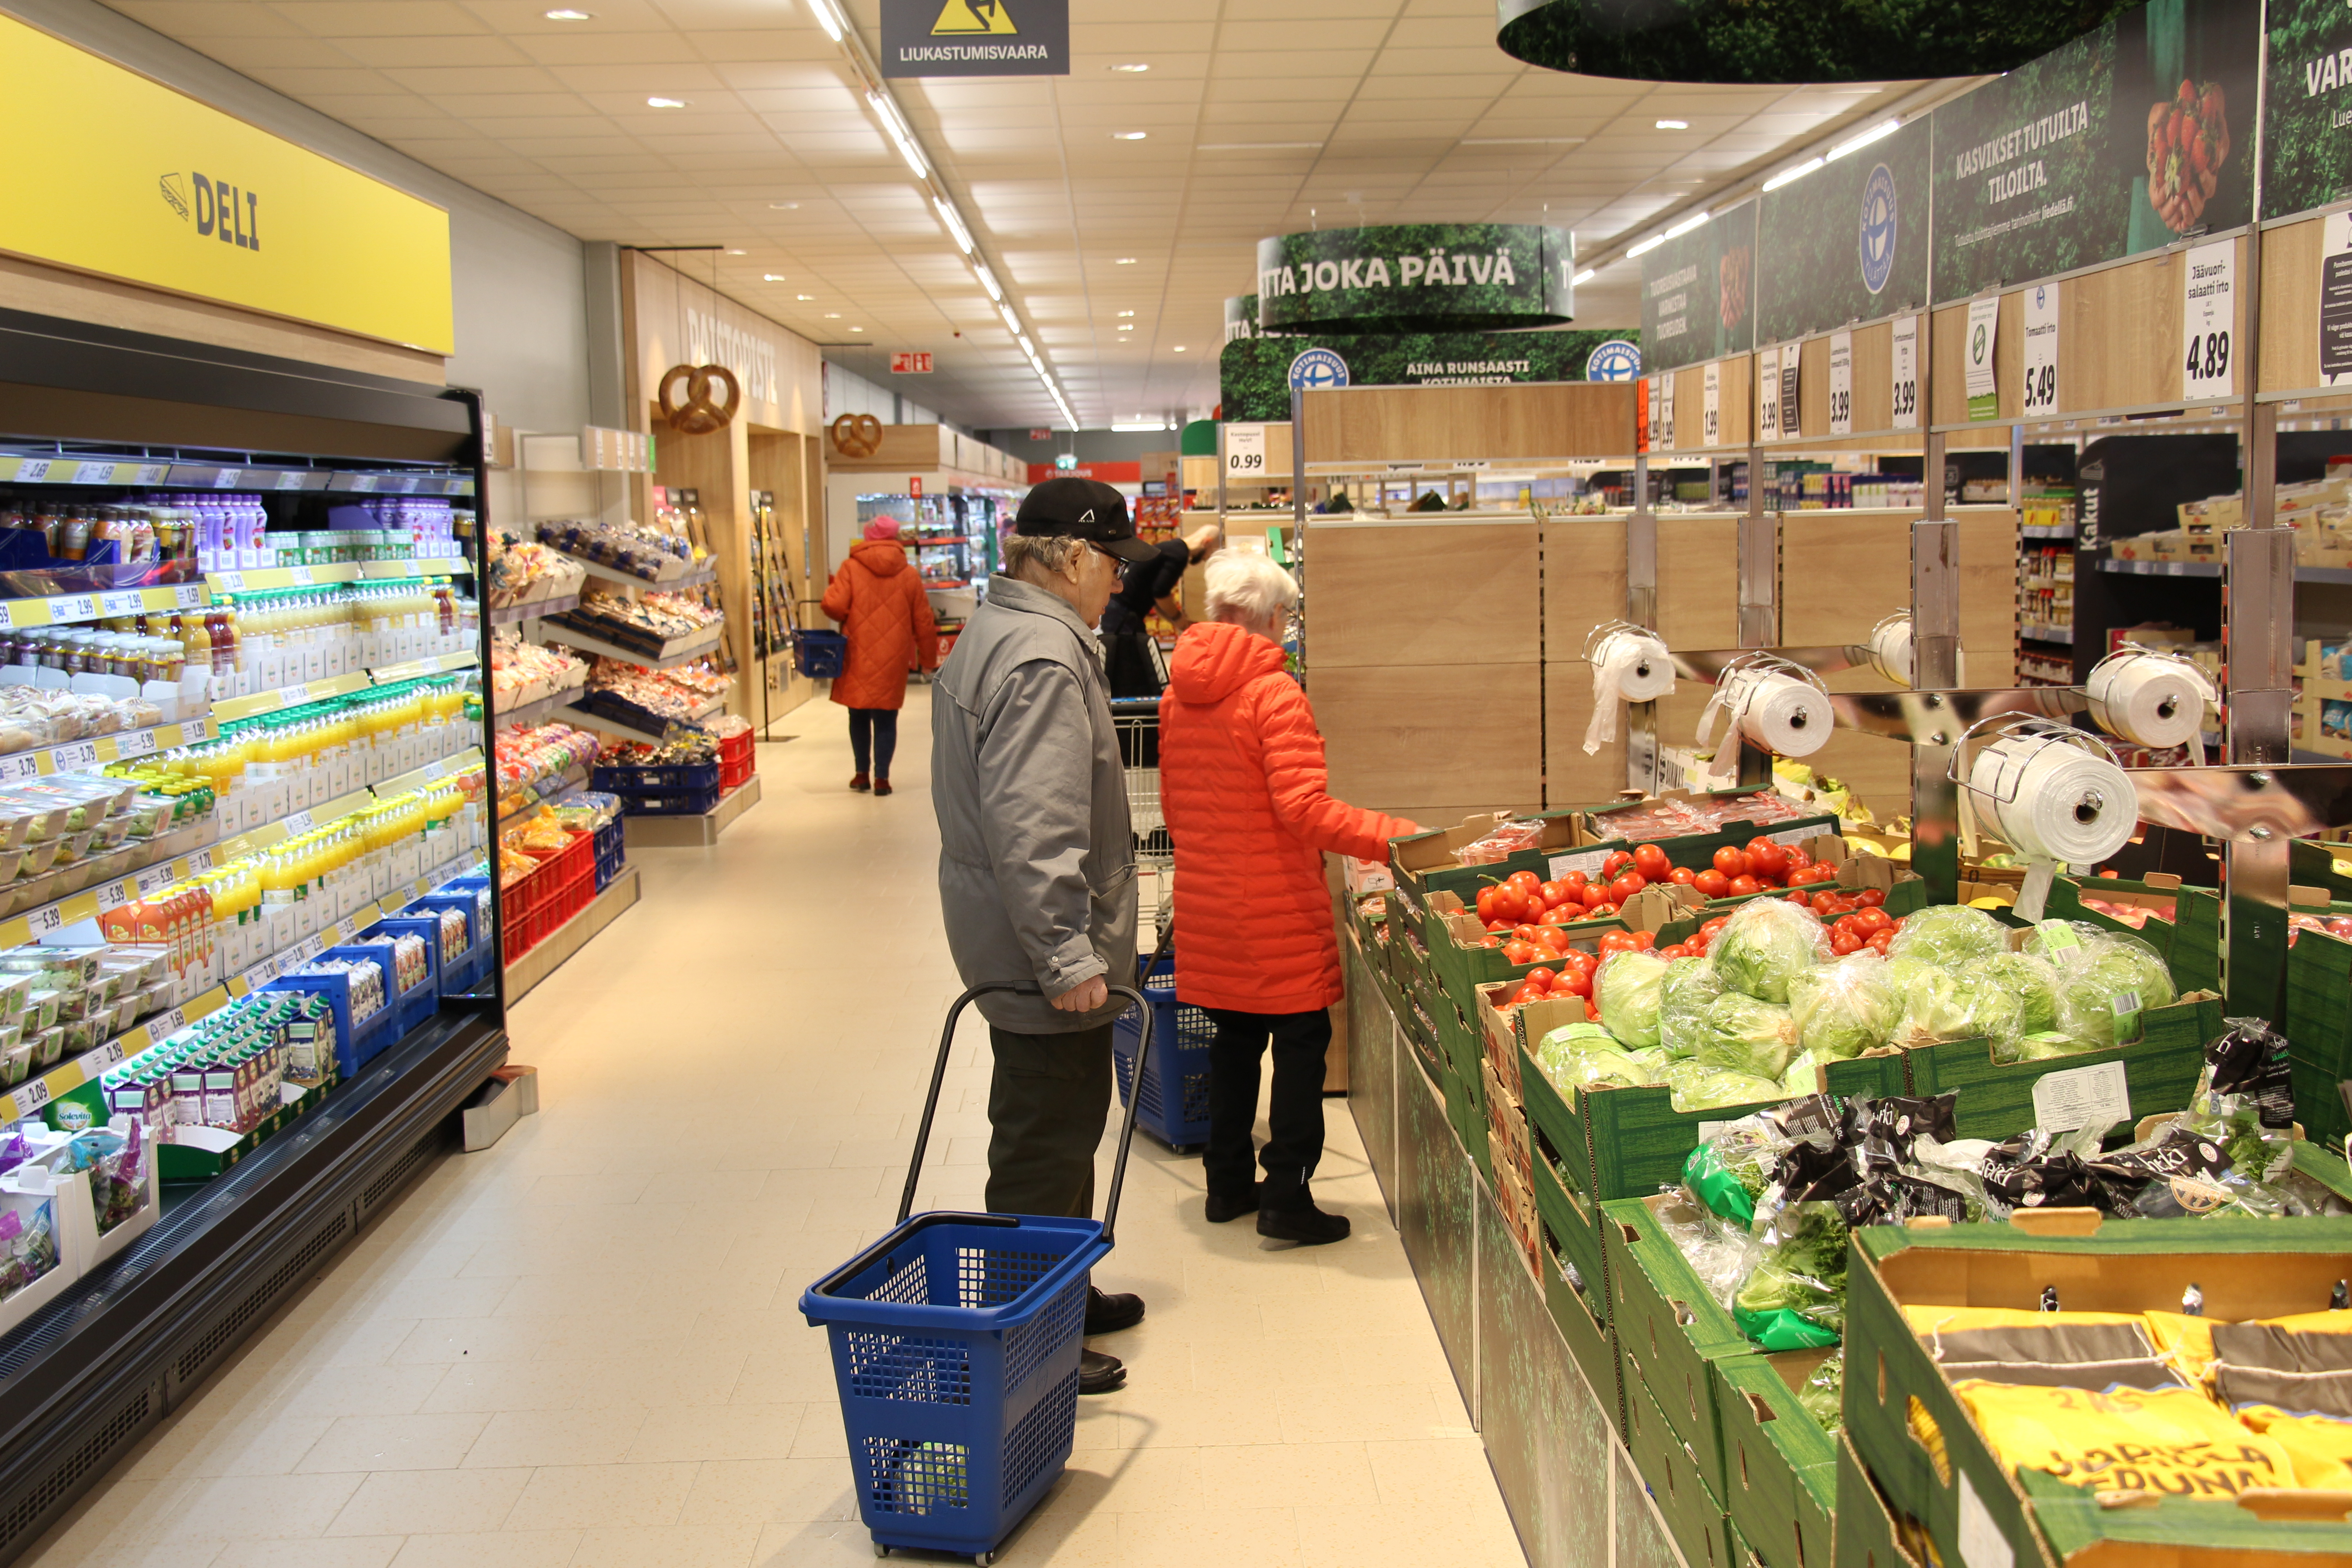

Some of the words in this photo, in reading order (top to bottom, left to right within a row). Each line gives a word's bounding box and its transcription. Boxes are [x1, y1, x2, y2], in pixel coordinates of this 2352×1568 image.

[900, 45, 1048, 62] LIUKASTUMISVAARA
[1956, 129, 2021, 181] KASVIKSET
[2023, 100, 2088, 153] TUTUILTA
[1988, 160, 2048, 205] TILOILTA.
[193, 172, 259, 251] DELI
[1300, 258, 1391, 294] JOKA
[1399, 248, 1515, 287] PÄIVÄ
[2192, 260, 2226, 280] Jäävuori-
[2188, 280, 2215, 299] salaatti
[2216, 278, 2229, 294] irto
[2186, 331, 2229, 380] 4.89
[1292, 354, 1346, 380] KOTIMAISUUS
[1406, 363, 1444, 376] AINA
[1447, 360, 1529, 375] RUNSAASTI
[2025, 364, 2055, 408] 5.49
[1831, 391, 1849, 423] 3.99
[1893, 380, 1915, 416] 3.99
[1705, 410, 1718, 436] 1.99
[1762, 402, 1776, 431] 3.99
[1230, 454, 1262, 469] 0.99
[2079, 487, 2099, 551] Kakut
[77, 599, 94, 616] 2.99
[127, 593, 142, 610] 2.99
[141, 732, 155, 750] 5.39
[192, 722, 205, 738] 1.39
[80, 745, 96, 763] 3.79
[19, 758, 36, 777] 3.79
[198, 852, 212, 869] 1.78
[160, 866, 174, 884] 5.39
[110, 882, 125, 904] 5.39
[43, 907, 60, 930] 5.39
[171, 1010, 184, 1029] 1.69
[107, 1039, 124, 1063] 2.19
[29, 1081, 48, 1104] 2.09
[59, 1112, 91, 1120] Solevita
